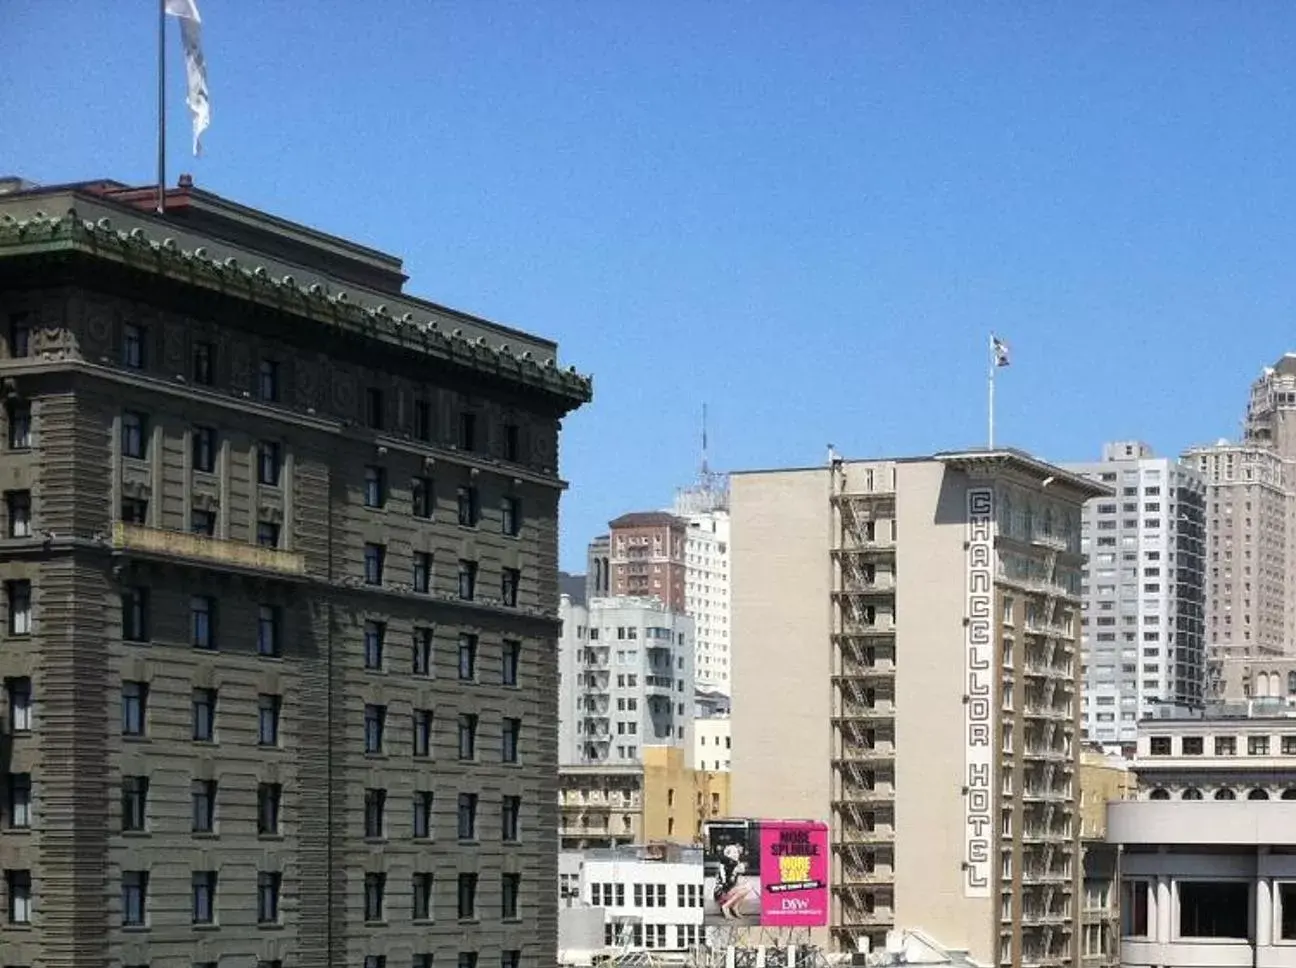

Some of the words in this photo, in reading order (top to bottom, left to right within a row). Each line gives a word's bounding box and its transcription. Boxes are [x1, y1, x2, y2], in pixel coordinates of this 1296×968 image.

[968, 491, 991, 746] CHANCELLOR
[780, 830, 811, 843] MORE
[967, 763, 989, 888] HOTEL
[779, 856, 811, 869] MORE
